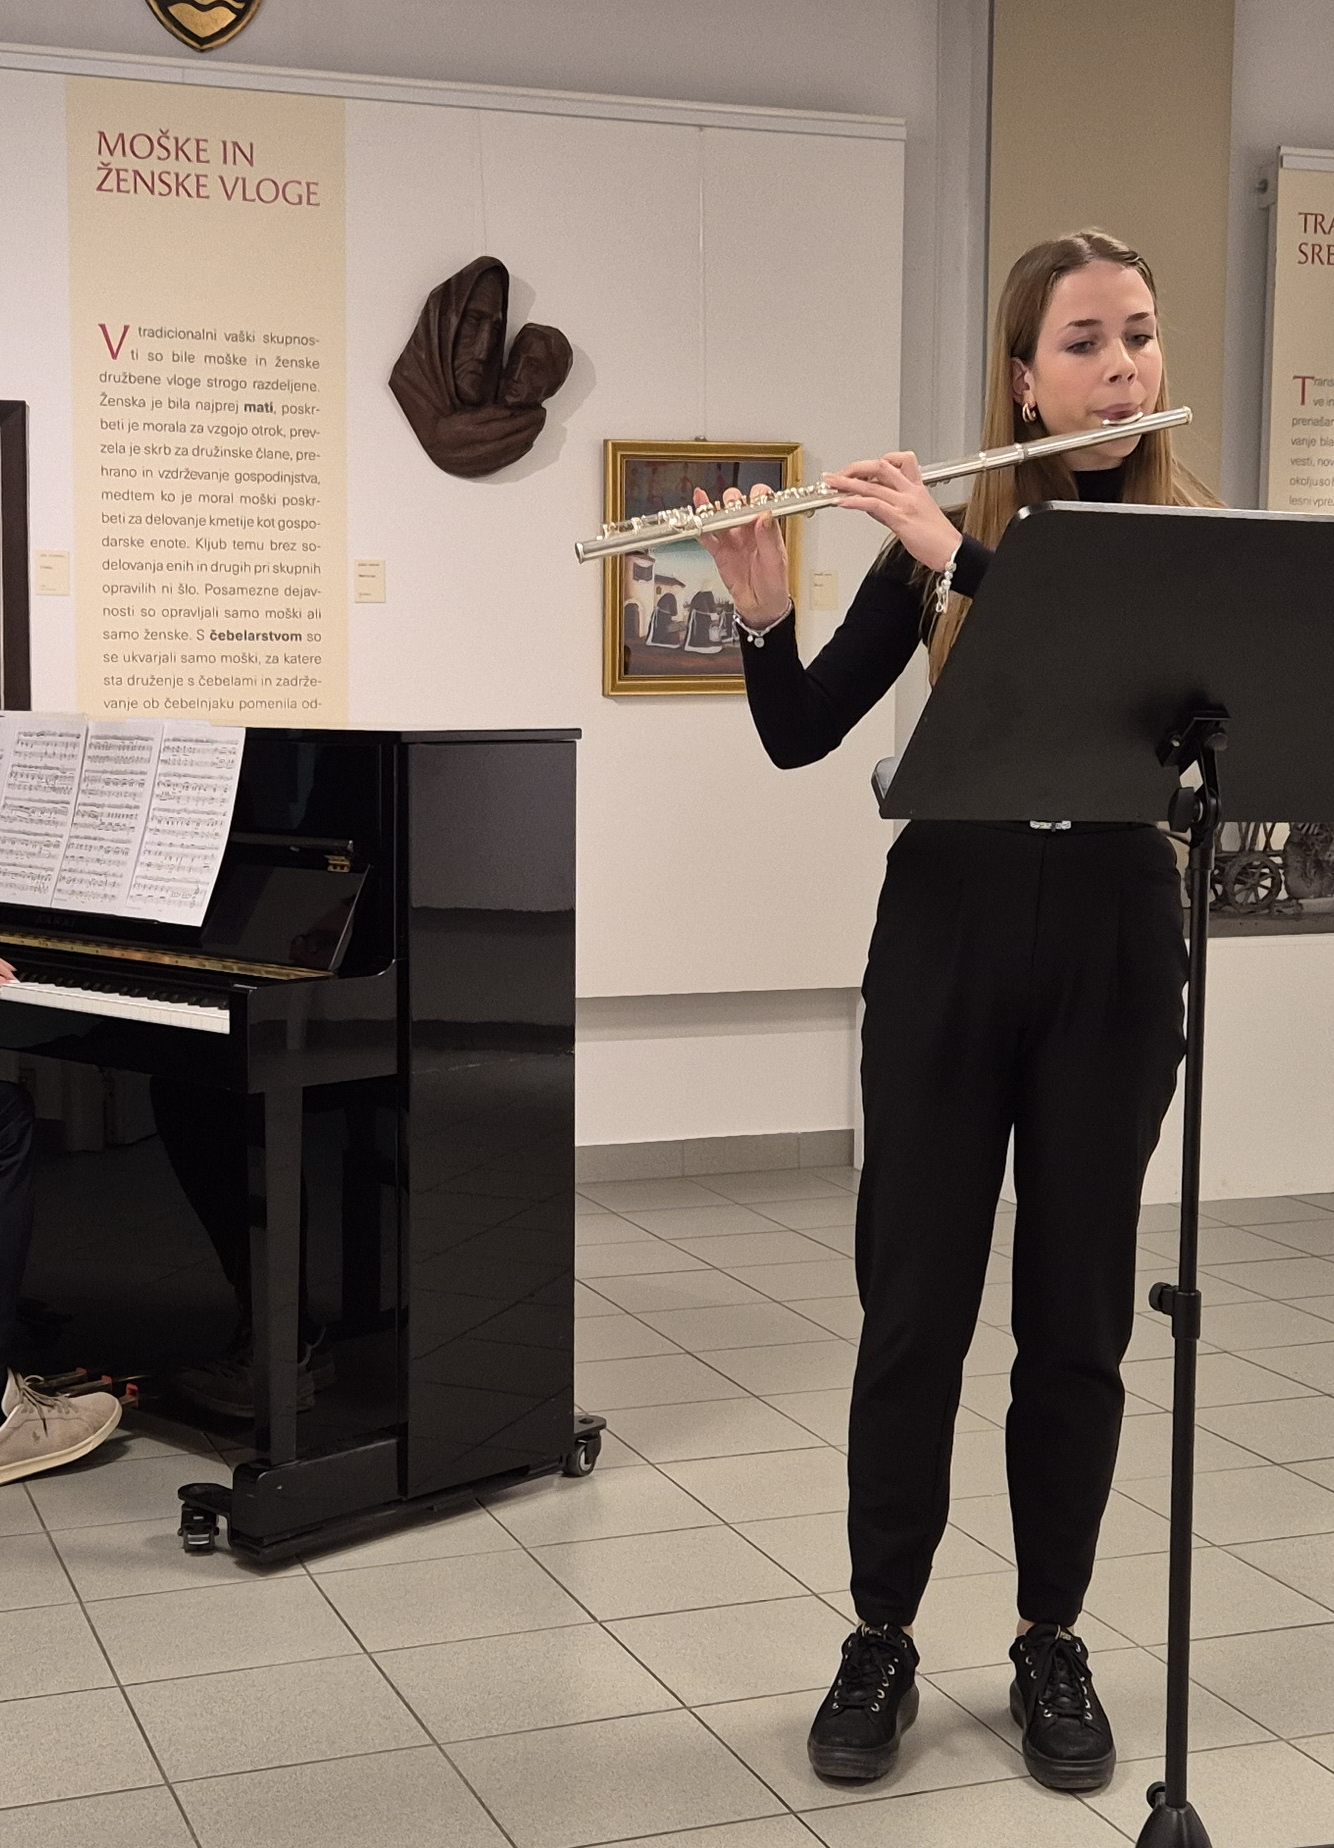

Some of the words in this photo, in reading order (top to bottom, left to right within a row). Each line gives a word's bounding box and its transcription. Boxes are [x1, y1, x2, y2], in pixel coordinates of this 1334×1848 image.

[97, 128, 211, 165] MOŠKE
[220, 139, 255, 168] IN
[95, 161, 211, 200] ŽENSKE
[218, 174, 321, 207] VLOGE
[97, 322, 130, 361] V
[137, 326, 217, 342] tradicionalni
[223, 330, 256, 344] vaški
[262, 332, 320, 348] skupnos-
[130, 348, 139, 361] ti
[147, 352, 164, 362] so
[171, 350, 196, 364] bile
[203, 352, 248, 367] moške
[255, 355, 267, 368] in
[274, 356, 320, 370] ženske
[98, 371, 162, 386] družbene
[166, 374, 202, 390] vloge
[206, 377, 248, 392] strogo
[252, 379, 320, 395] razdeljene.
[99, 392, 147, 409] Ženska
[150, 397, 163, 412] je
[167, 397, 191, 411] bila
[195, 399, 239, 415] najprej
[243, 401, 277, 416] mati,
[281, 403, 320, 417] poskr-
[100, 418, 125, 431] beti
[127, 419, 140, 434] je
[142, 421, 187, 434] morala
[189, 424, 205, 435] za
[206, 423, 249, 439] vzgojo
[251, 425, 287, 439] otrok,
[289, 428, 321, 440] prev-
[100, 442, 126, 455] zela
[129, 442, 141, 458] je
[143, 443, 172, 456] skrb
[174, 446, 189, 457] za
[191, 445, 254, 459] družinske
[255, 447, 293, 462] člane,
[295, 451, 321, 463] pre-
[100, 465, 138, 479] hrano
[141, 466, 154, 479] in
[157, 467, 230, 484] vzdrževanje
[234, 471, 321, 487] gospodinjstva,
[101, 489, 155, 502] medtem
[160, 490, 176, 503] ko
[180, 491, 193, 506] je
[198, 492, 234, 505] moral
[239, 493, 277, 506] moški
[282, 494, 321, 509] poskr-
[101, 512, 126, 525] beti
[127, 515, 143, 525] za
[144, 513, 207, 529] delovanje
[209, 515, 255, 531] kmetije
[256, 516, 276, 529] kot
[277, 519, 321, 532] gospo-
[101, 535, 145, 549] darske
[149, 538, 190, 550] enote.
[195, 537, 228, 553] Kljub
[232, 540, 265, 551] temu
[269, 539, 297, 552] brez
[301, 543, 321, 553] so-
[101, 558, 164, 575] delovanja
[165, 560, 194, 572] enih
[196, 561, 208, 573] in
[210, 561, 252, 576] drugih
[253, 562, 270, 577] pri
[272, 562, 321, 577] skupnih
[101, 582, 157, 597] opravilih
[161, 583, 173, 596] ni
[177, 583, 199, 596] šlo.
[204, 583, 279, 597] Posamezne
[283, 585, 322, 600] dejav-
[102, 605, 135, 618] nosti
[140, 608, 156, 618] so
[161, 606, 219, 621] opravljali
[224, 609, 260, 619] samo
[264, 608, 302, 620] moški
[306, 608, 322, 620] ali
[102, 631, 140, 641] samo
[143, 628, 192, 642] ženske.
[196, 629, 205, 642] S
[209, 629, 303, 643] čebelarstvom
[306, 633, 322, 643] so
[102, 654, 119, 663] se
[123, 651, 177, 666] ukvarjali
[180, 655, 217, 664] samo
[220, 652, 261, 666] moški,
[265, 655, 280, 665] za
[283, 653, 322, 665] katere
[103, 676, 123, 687] sta
[126, 674, 184, 690] druženje
[187, 678, 195, 687] s
[198, 675, 258, 687] čebelami
[261, 678, 273, 687] in
[275, 675, 322, 688] zadrže-
[103, 697, 139, 712] vanje
[142, 697, 160, 710] ob
[163, 697, 235, 712] čebelnjaku
[238, 698, 298, 712] pomenila
[301, 698, 322, 710] od-
